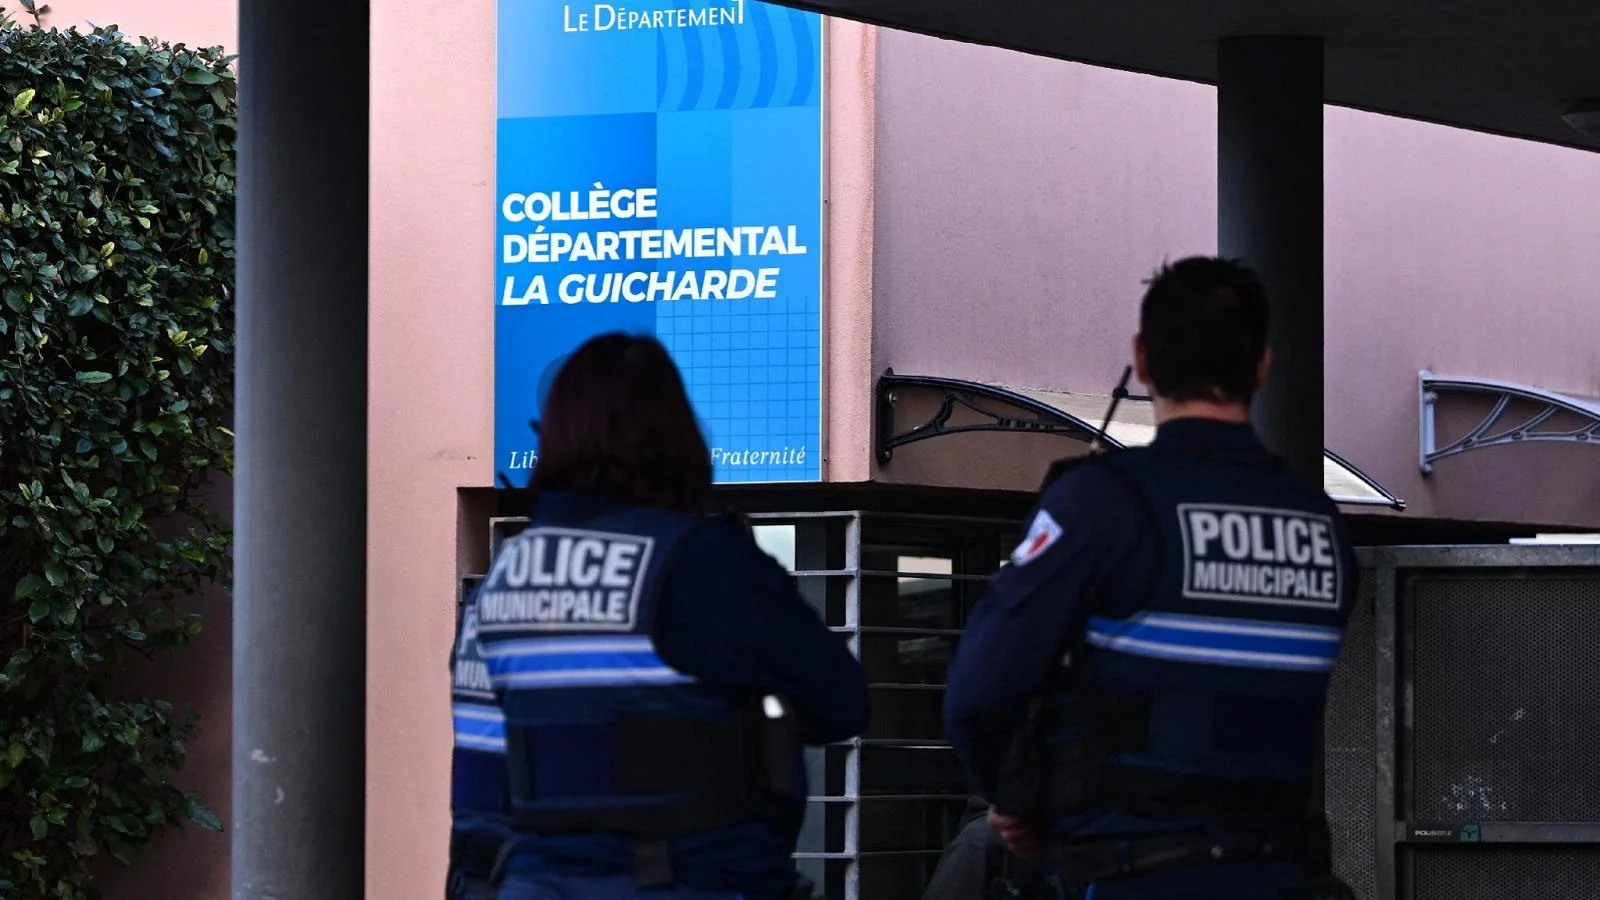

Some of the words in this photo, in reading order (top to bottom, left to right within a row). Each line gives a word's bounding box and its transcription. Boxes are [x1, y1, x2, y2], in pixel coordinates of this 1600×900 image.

[564, 5, 589, 32] LE
[502, 181, 657, 222] COLLÈGE
[503, 225, 807, 263] DÉPARTEMENTAL
[502, 275, 549, 306] LA
[558, 267, 780, 304] GUICHARDE
[509, 450, 539, 469] Lib
[711, 446, 806, 466] Fraternité
[1189, 511, 1334, 566] POLICE
[1193, 560, 1335, 600] MUNICIPALE
[480, 590, 627, 622] MUNICIPALE
